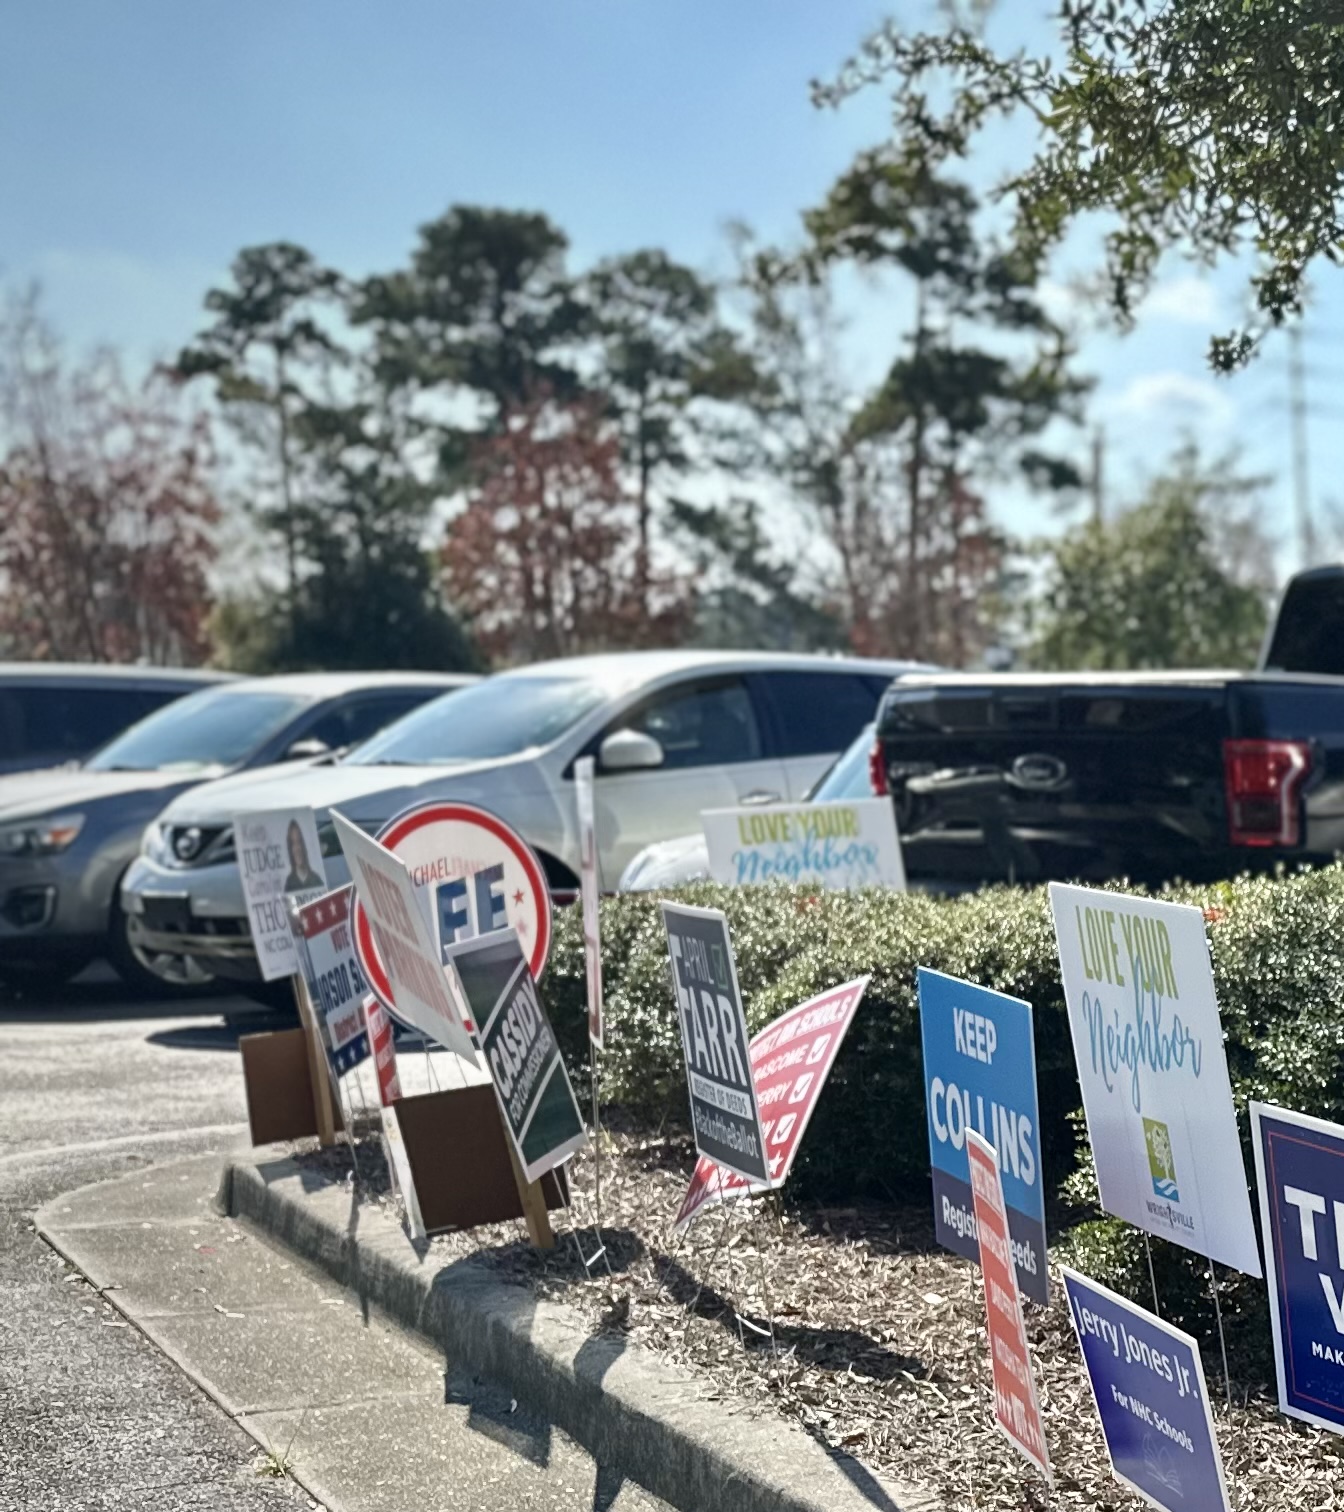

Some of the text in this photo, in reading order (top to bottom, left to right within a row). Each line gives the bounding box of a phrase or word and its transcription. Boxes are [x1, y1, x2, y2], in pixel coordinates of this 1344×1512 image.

[737, 806, 860, 845] LOVE YOUR
[243, 845, 285, 877] JUDGE
[408, 856, 450, 887] ICHAEL
[681, 934, 715, 985] APRIL
[1075, 905, 1179, 1000] LOVE YOUR
[490, 973, 543, 1099] CASSIDY
[679, 985, 748, 1087] TARR
[953, 1007, 997, 1065] KEEP
[1082, 955, 1201, 1114] Neighbor
[757, 1081, 792, 1108] ERRY
[942, 1194, 977, 1241] Regist
[1009, 1238, 1037, 1276] eeds
[1073, 1296, 1120, 1358] Jerry
[1121, 1323, 1174, 1383] Jones
[1111, 1384, 1195, 1453] For NHC Schools
